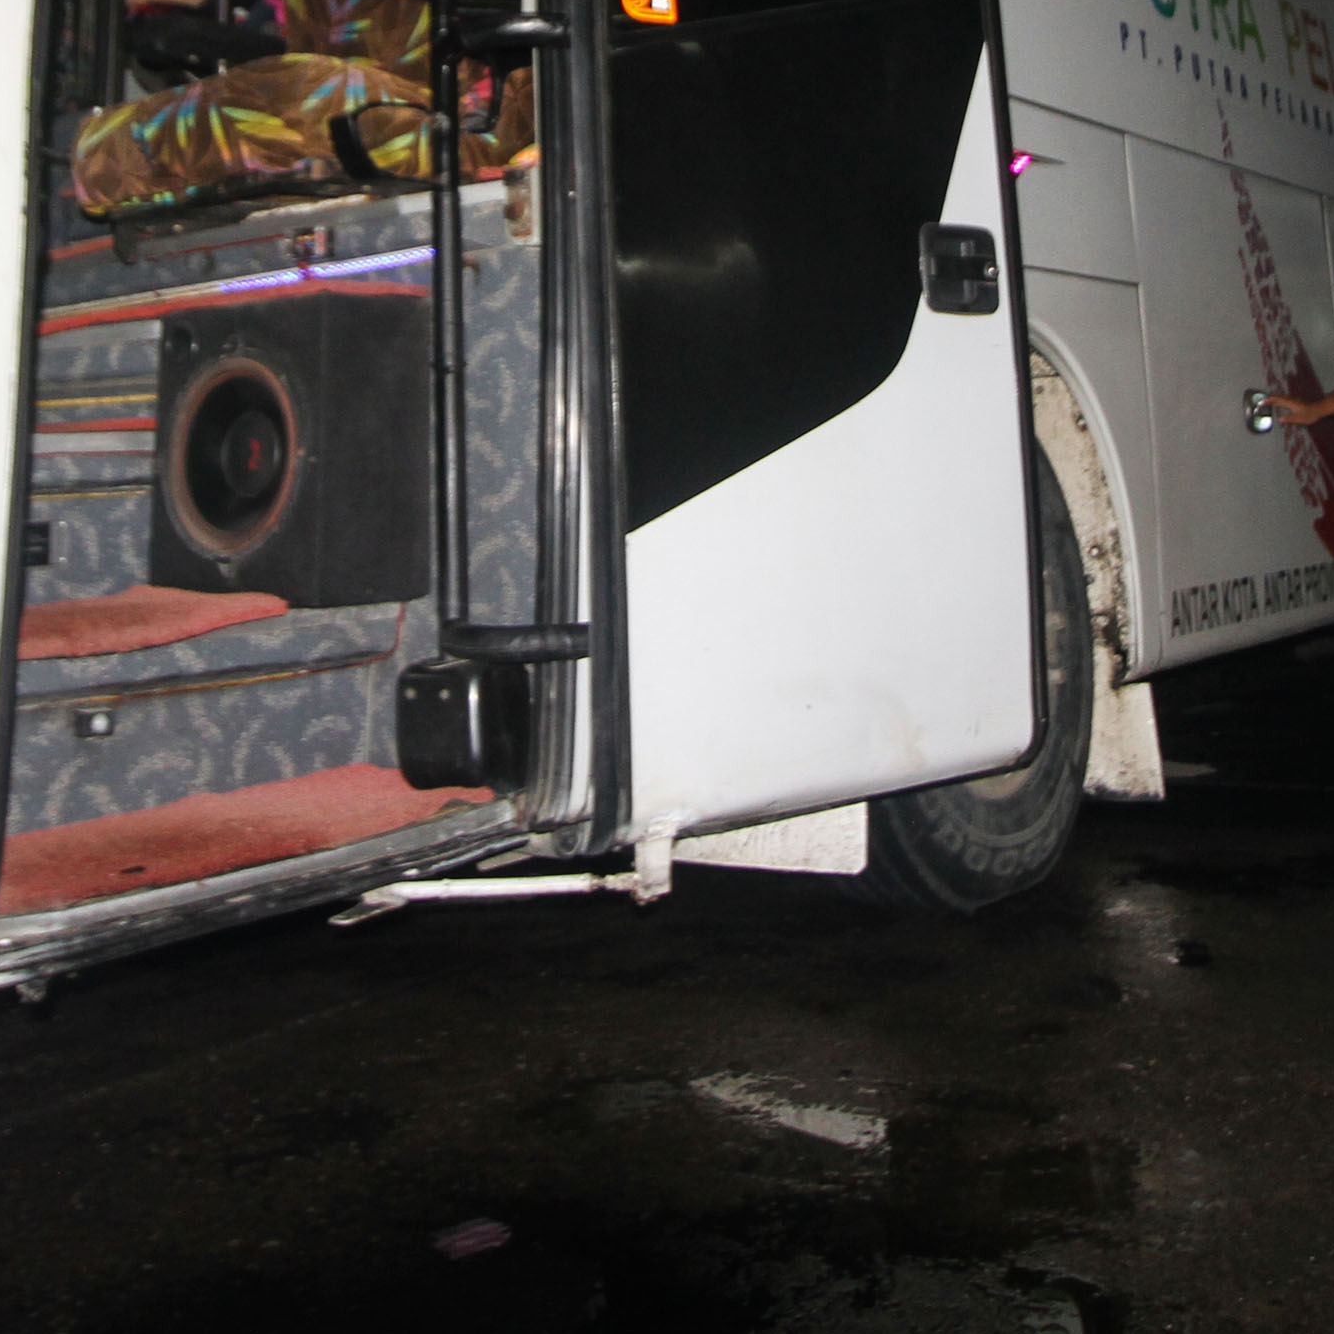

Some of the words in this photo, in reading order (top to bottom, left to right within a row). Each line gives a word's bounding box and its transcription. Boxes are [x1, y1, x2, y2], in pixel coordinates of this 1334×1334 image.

[1174, 44, 1248, 100] PUTRA
[1171, 582, 1222, 637] ANTAR
[1221, 576, 1260, 626] KOTA
[1264, 567, 1304, 614] ANTAR
